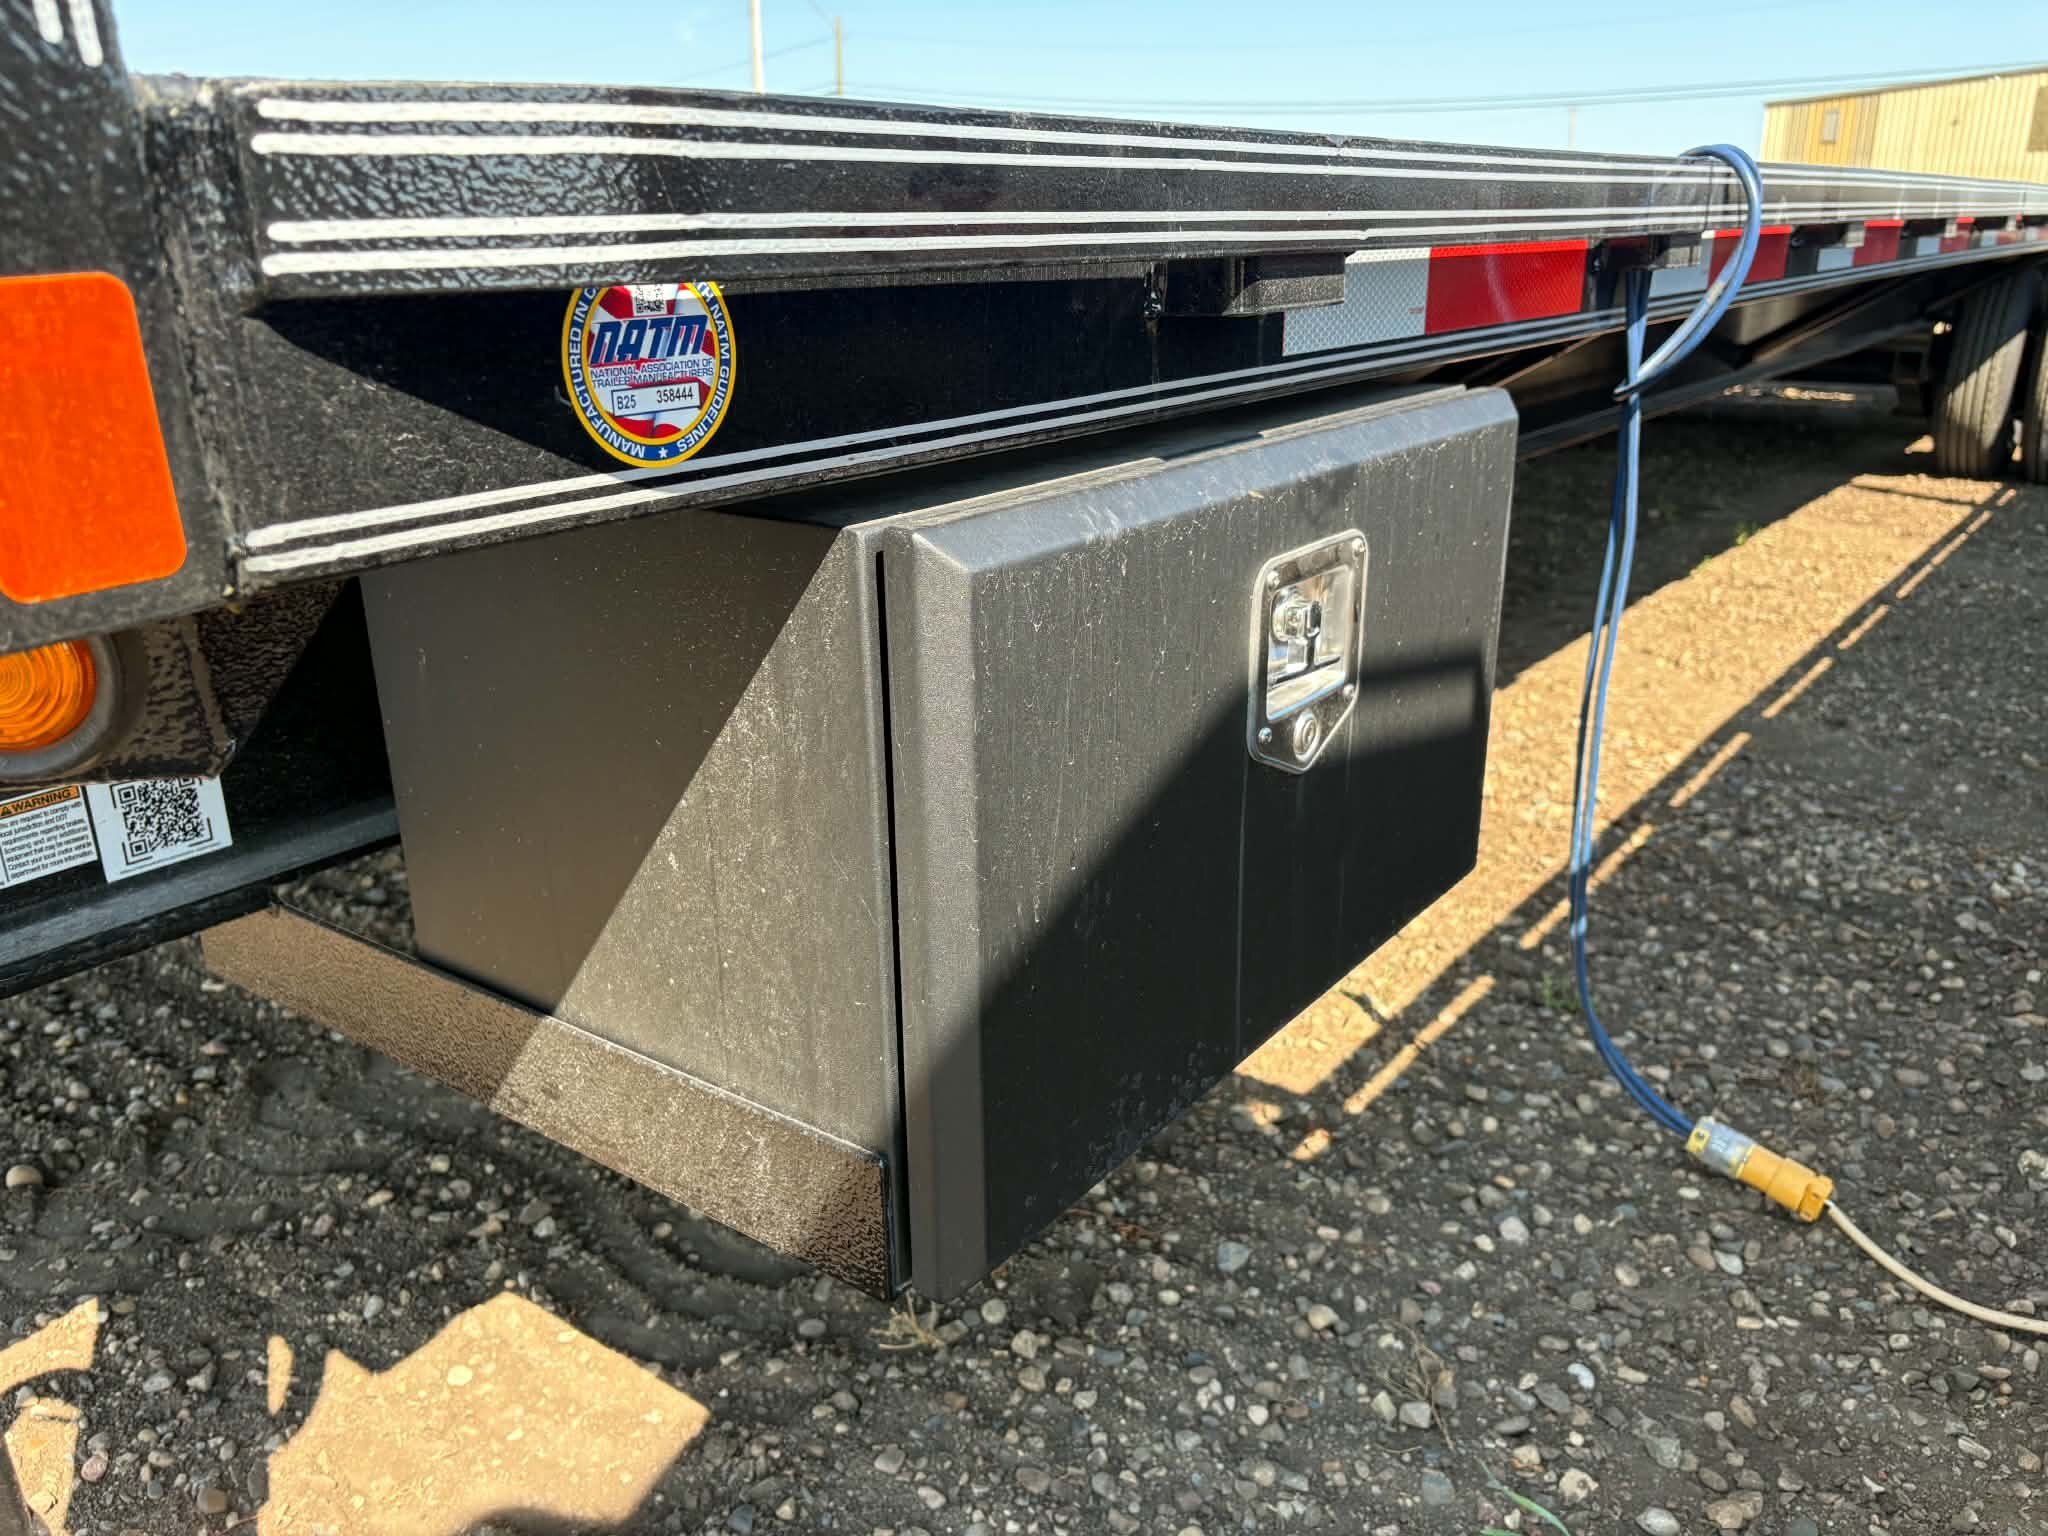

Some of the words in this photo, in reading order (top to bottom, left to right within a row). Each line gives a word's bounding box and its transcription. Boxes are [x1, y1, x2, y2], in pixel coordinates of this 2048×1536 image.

[574, 302, 588, 322] IN
[590, 314, 709, 365] NATM
[711, 303, 731, 353] NATM
[591, 365, 637, 378] NATIONAL
[640, 359, 700, 374] ASSOCIATION
[701, 358, 713, 368] OF
[592, 376, 631, 388] TRAILER
[633, 367, 713, 384] MANUFACTURERS
[568, 330, 646, 458] MANUFACTURED
[656, 386, 693, 404] 358444
[678, 365, 731, 449] GUIDELINES
[11, 789, 71, 812] WARNING
